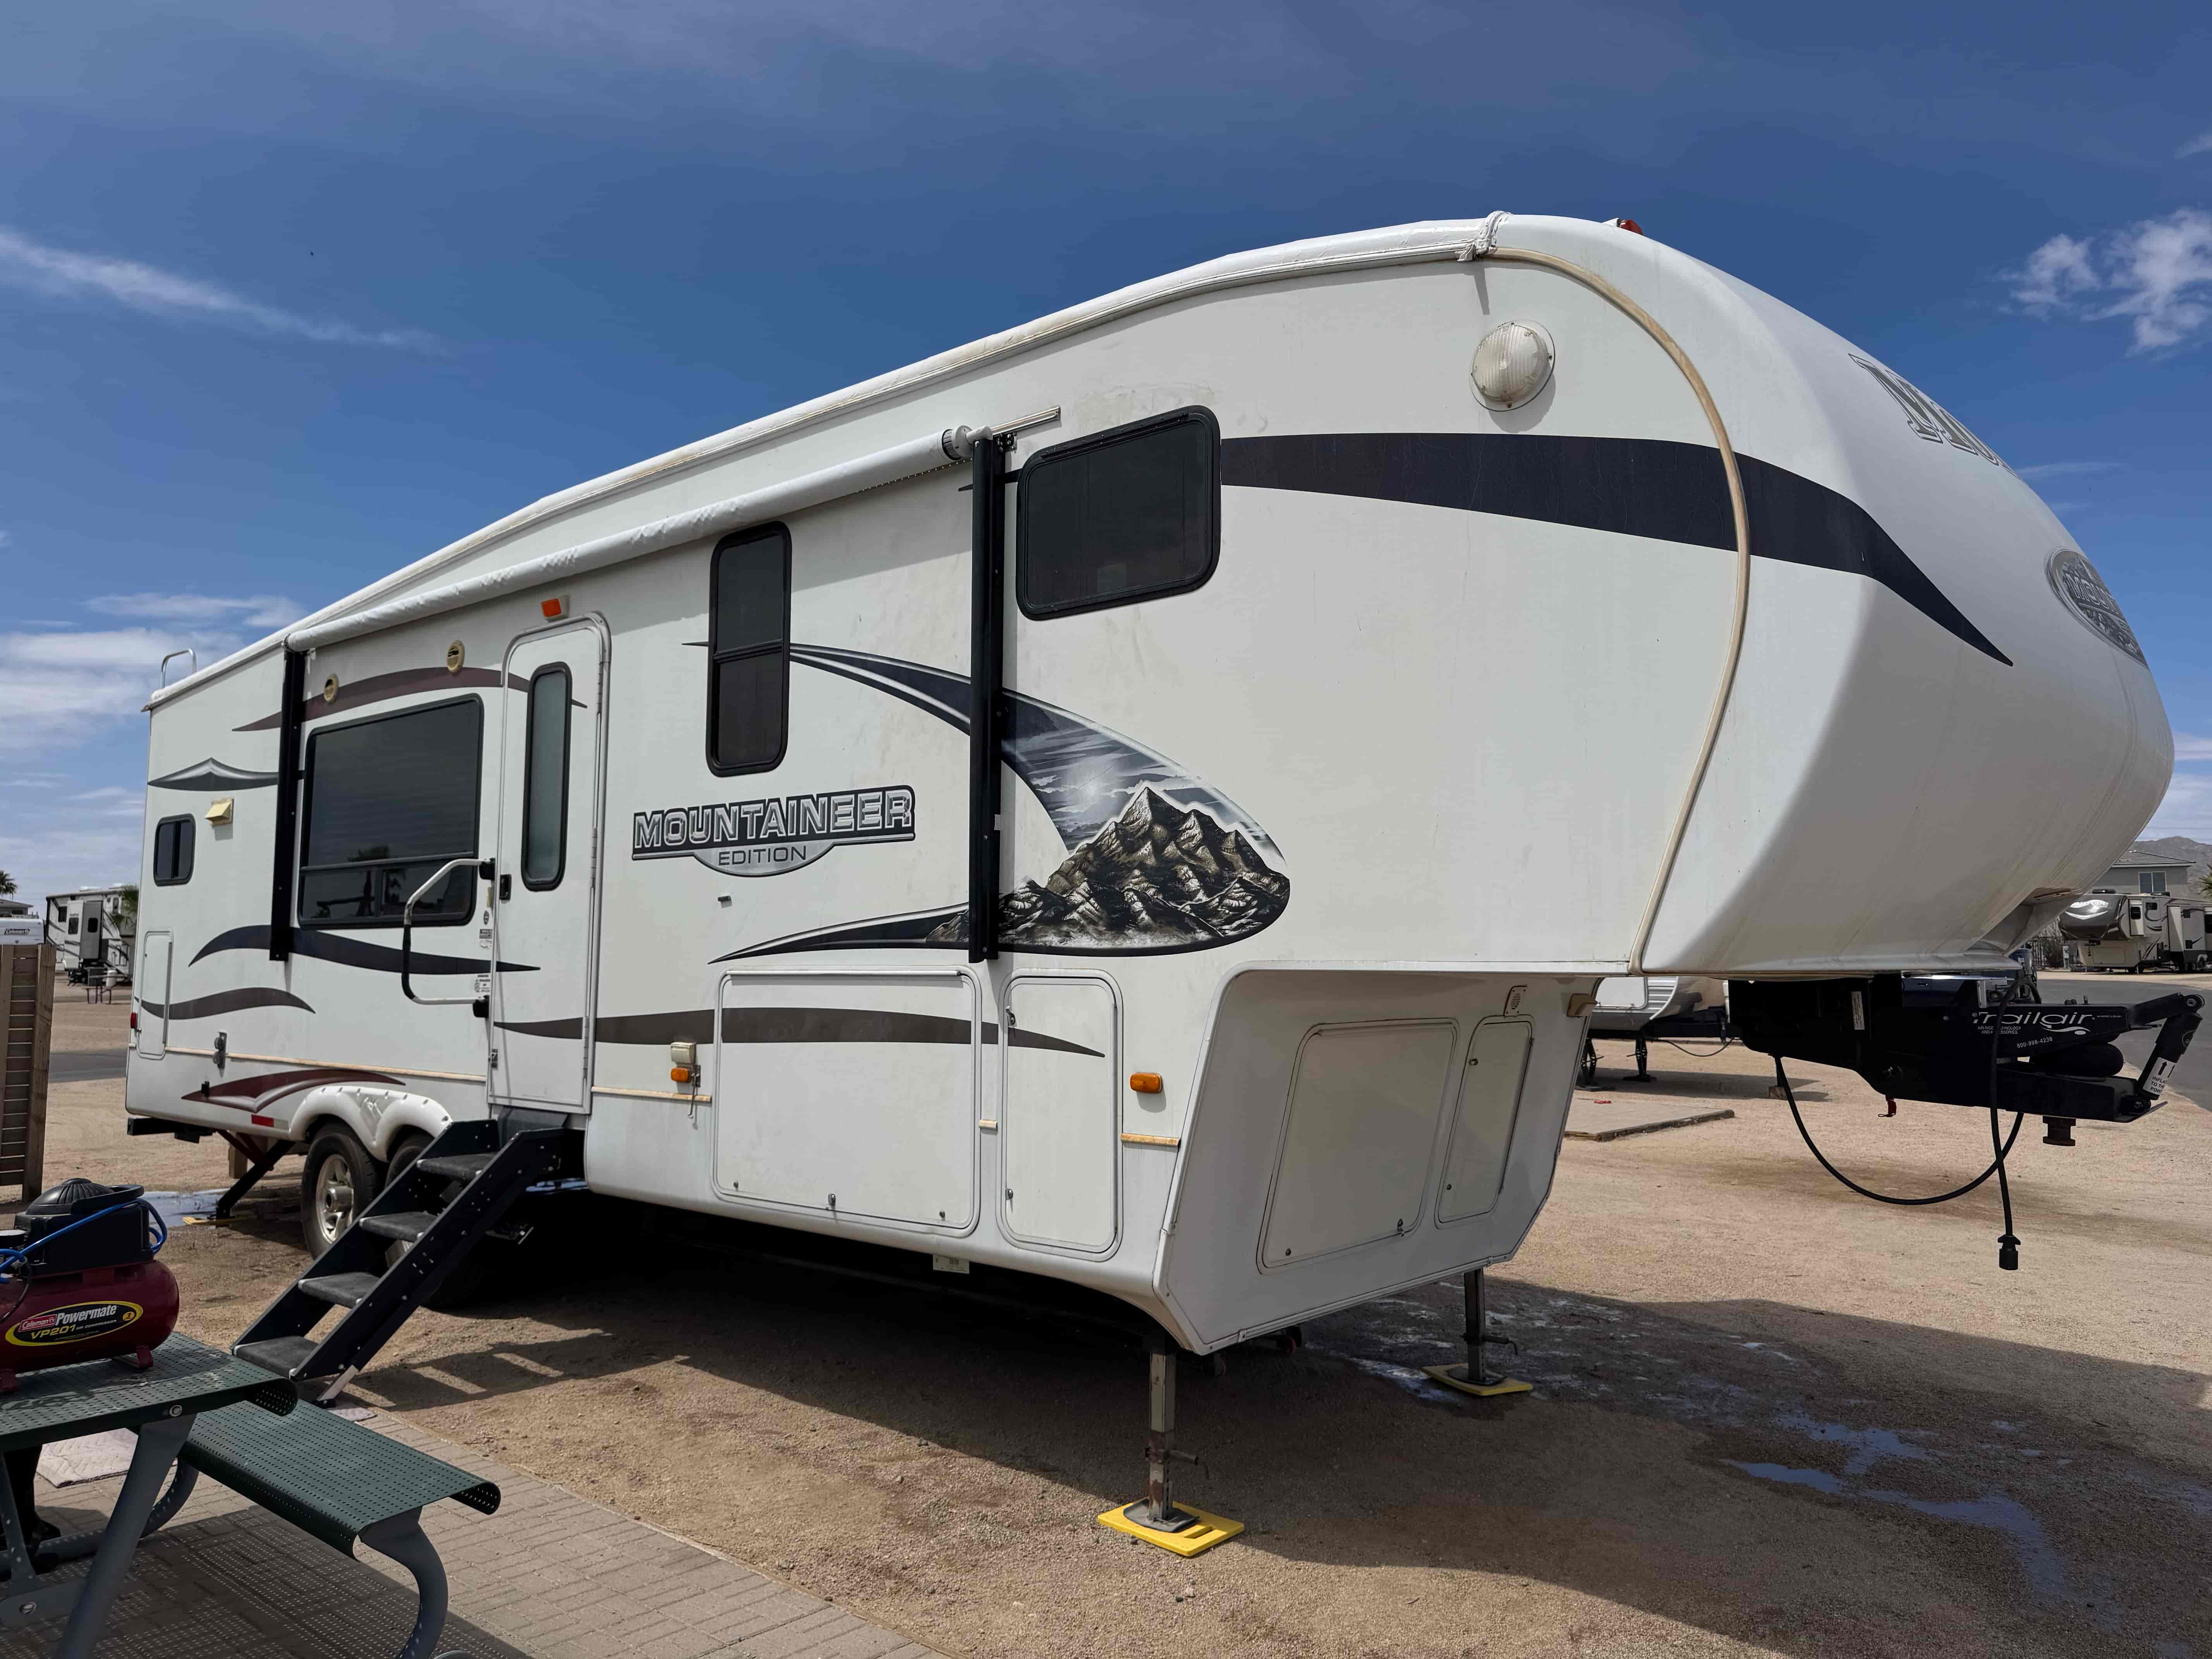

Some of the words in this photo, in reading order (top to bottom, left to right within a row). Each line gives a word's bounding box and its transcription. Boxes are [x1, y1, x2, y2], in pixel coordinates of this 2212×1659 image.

[634, 788, 912, 849] MOUNTAINEER
[718, 845, 807, 866] EDITION
[2016, 1036, 2053, 1048] 800-998-4238
[21, 1319, 50, 1330] Coleman
[55, 1305, 117, 1326] Powermate
[31, 1324, 77, 1340] VP201
